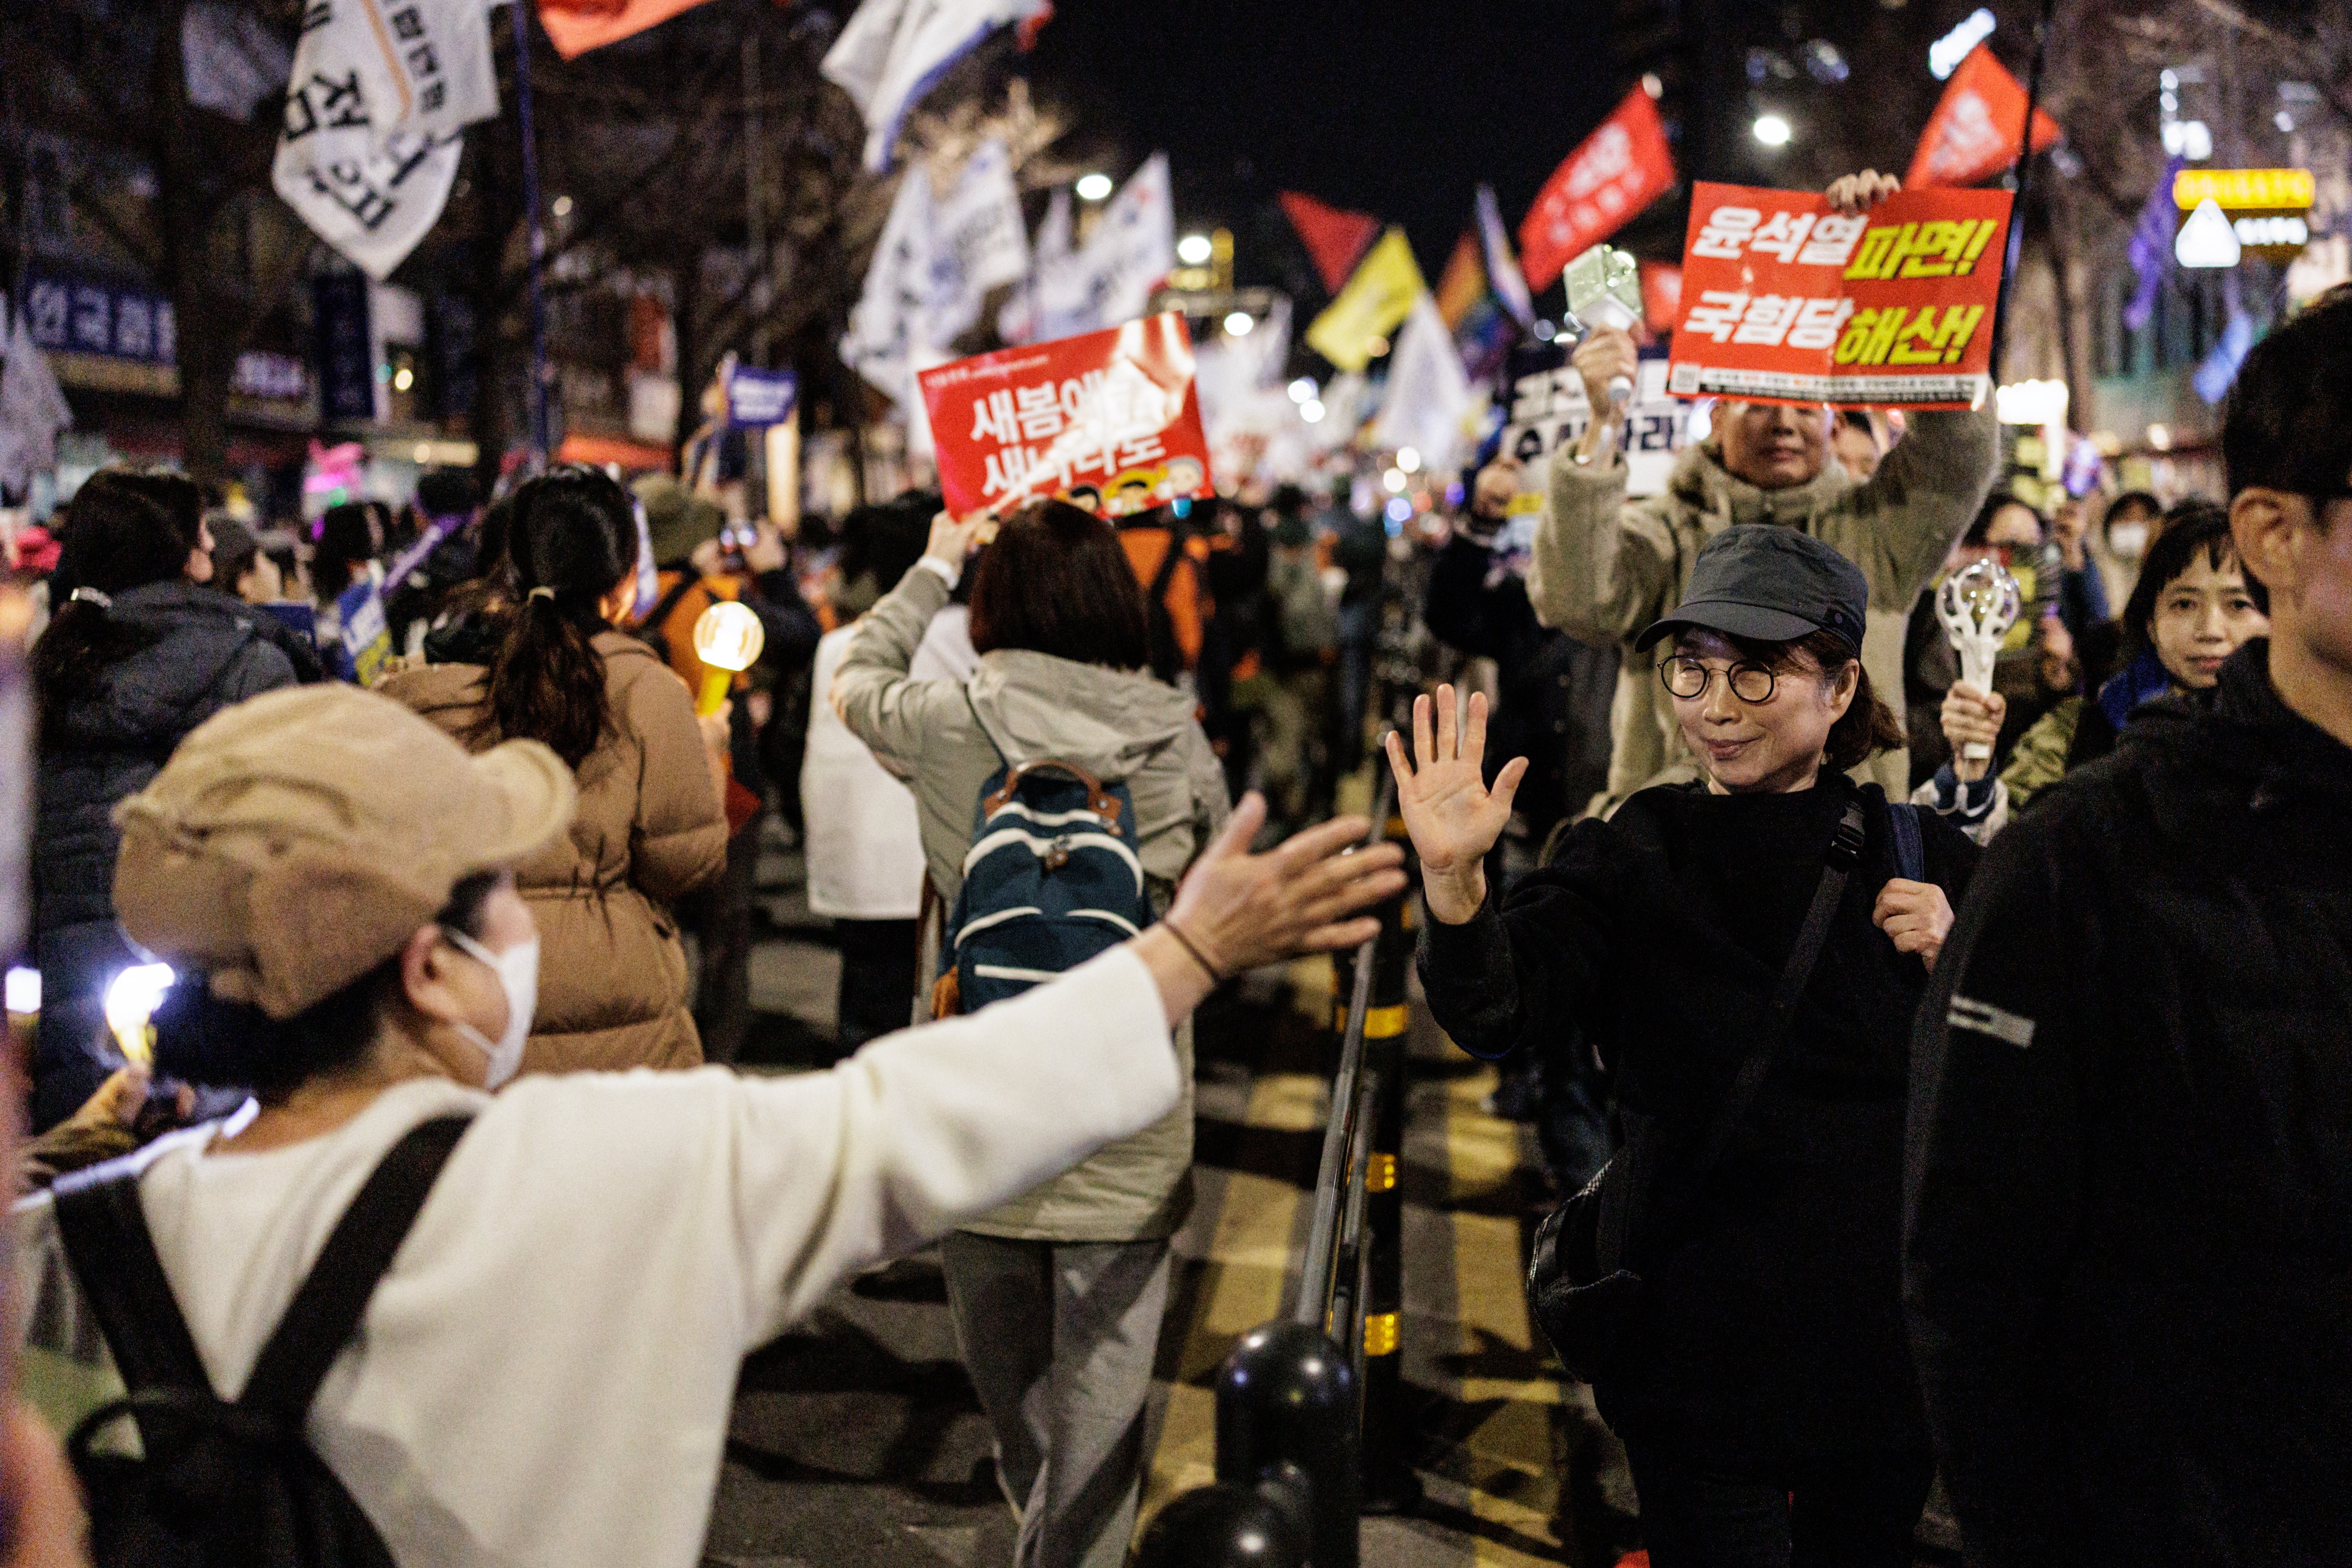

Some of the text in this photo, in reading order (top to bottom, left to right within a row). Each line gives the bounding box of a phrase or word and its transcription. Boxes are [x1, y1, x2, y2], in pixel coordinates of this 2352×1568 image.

[1691, 206, 1998, 281] 윤석열 파면!
[1684, 290, 1985, 365] 국힘당 해산!
